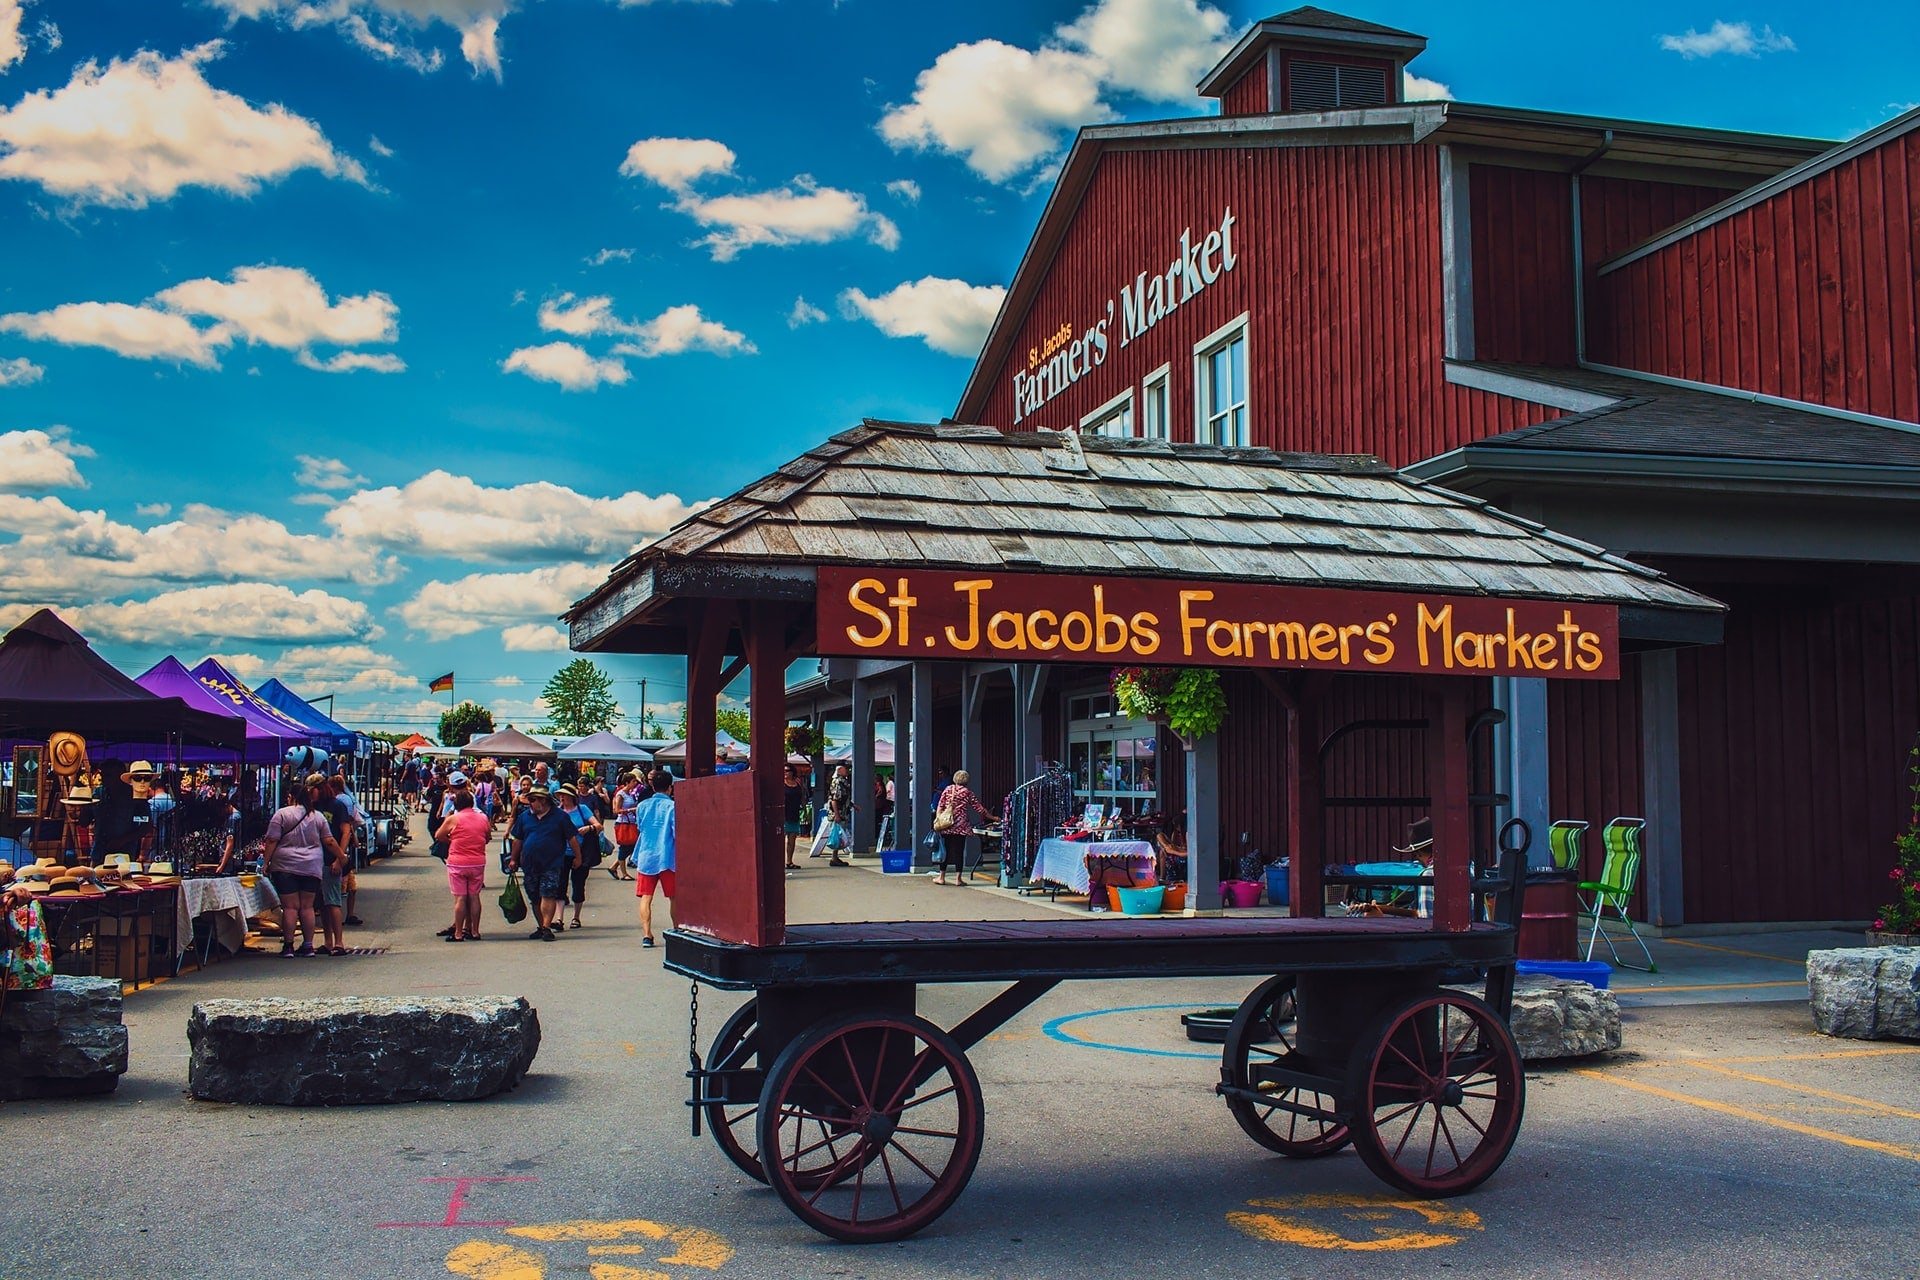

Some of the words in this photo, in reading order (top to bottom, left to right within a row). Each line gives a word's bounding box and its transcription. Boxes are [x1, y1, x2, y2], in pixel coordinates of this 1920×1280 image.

[1013, 299, 1114, 425] Farmers'
[1120, 205, 1237, 348] Market
[1029, 346, 1041, 370] St.
[1041, 322, 1072, 360] Jacobs
[846, 577, 936, 648] St.
[944, 578, 1161, 656] Jacobs
[1179, 590, 1398, 665] Farmers'
[1416, 602, 1603, 671] Markets
